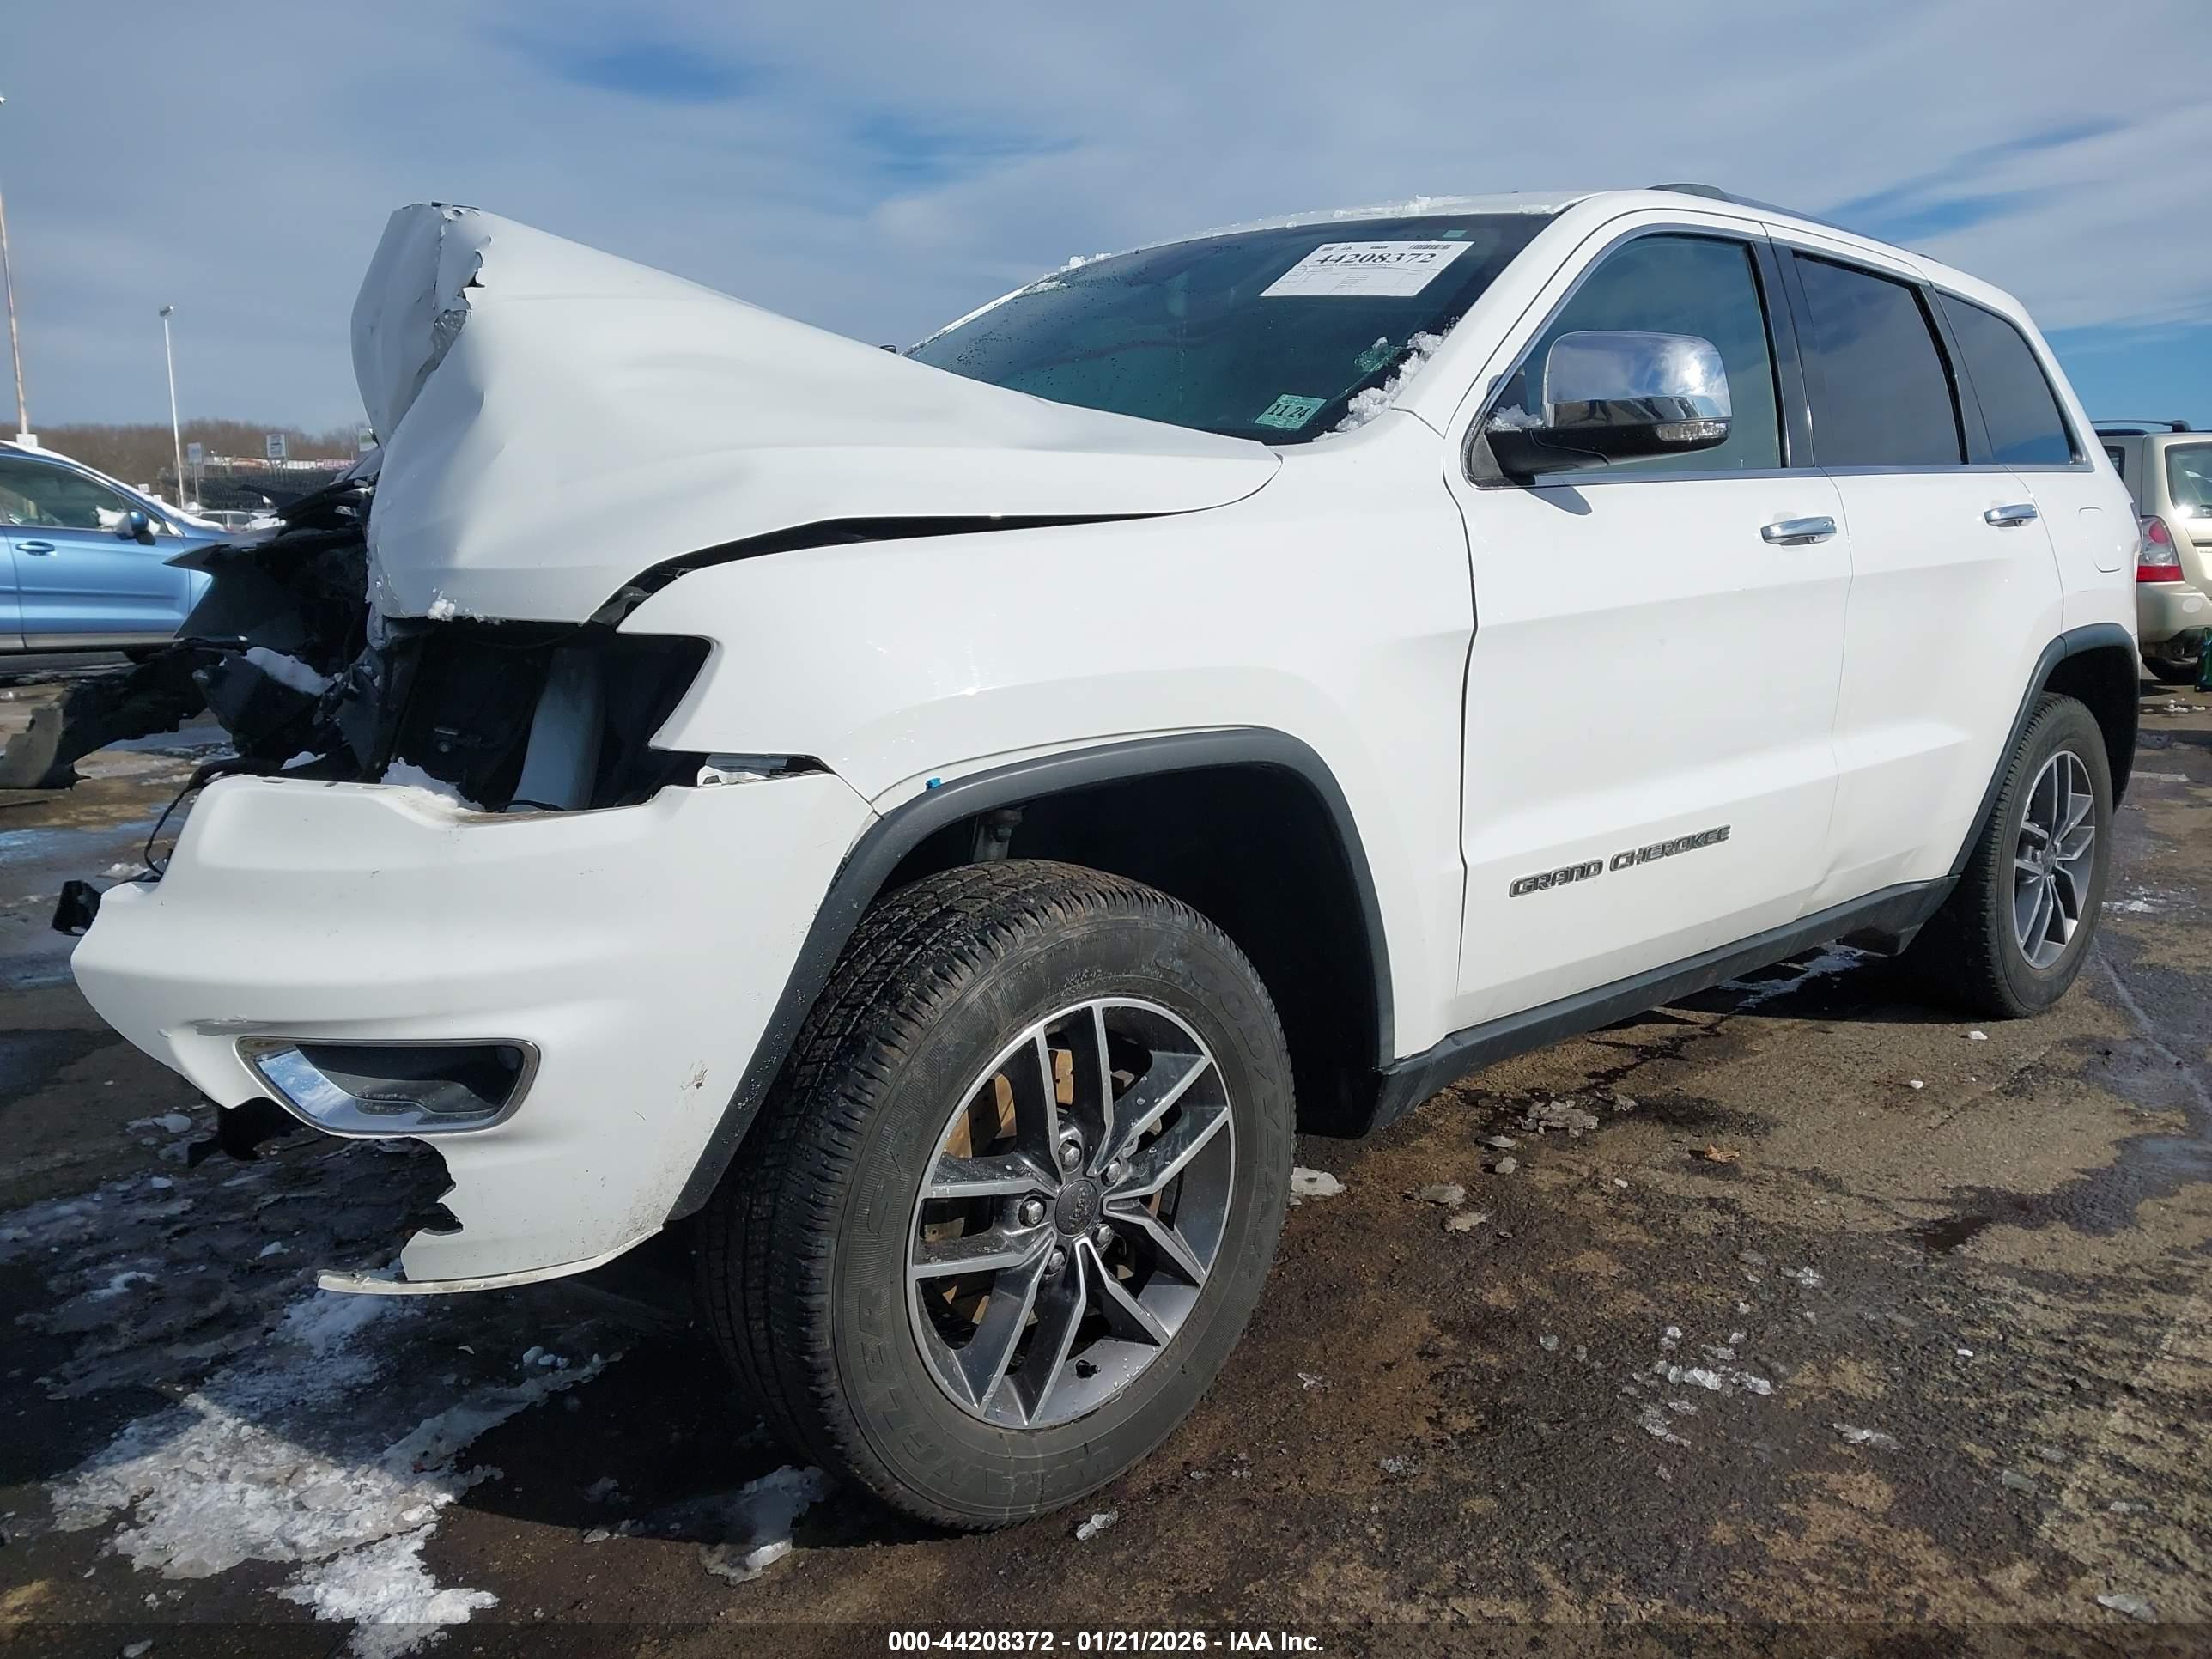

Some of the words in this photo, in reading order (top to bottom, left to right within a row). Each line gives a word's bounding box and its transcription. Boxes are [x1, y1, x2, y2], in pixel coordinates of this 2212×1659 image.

[1316, 252, 1437, 264] 44208372
[1267, 404, 1291, 416] 11
[1287, 406, 1312, 420] 24
[1508, 859, 1604, 898] GRAND
[1608, 824, 1732, 872] CHEROKEE
